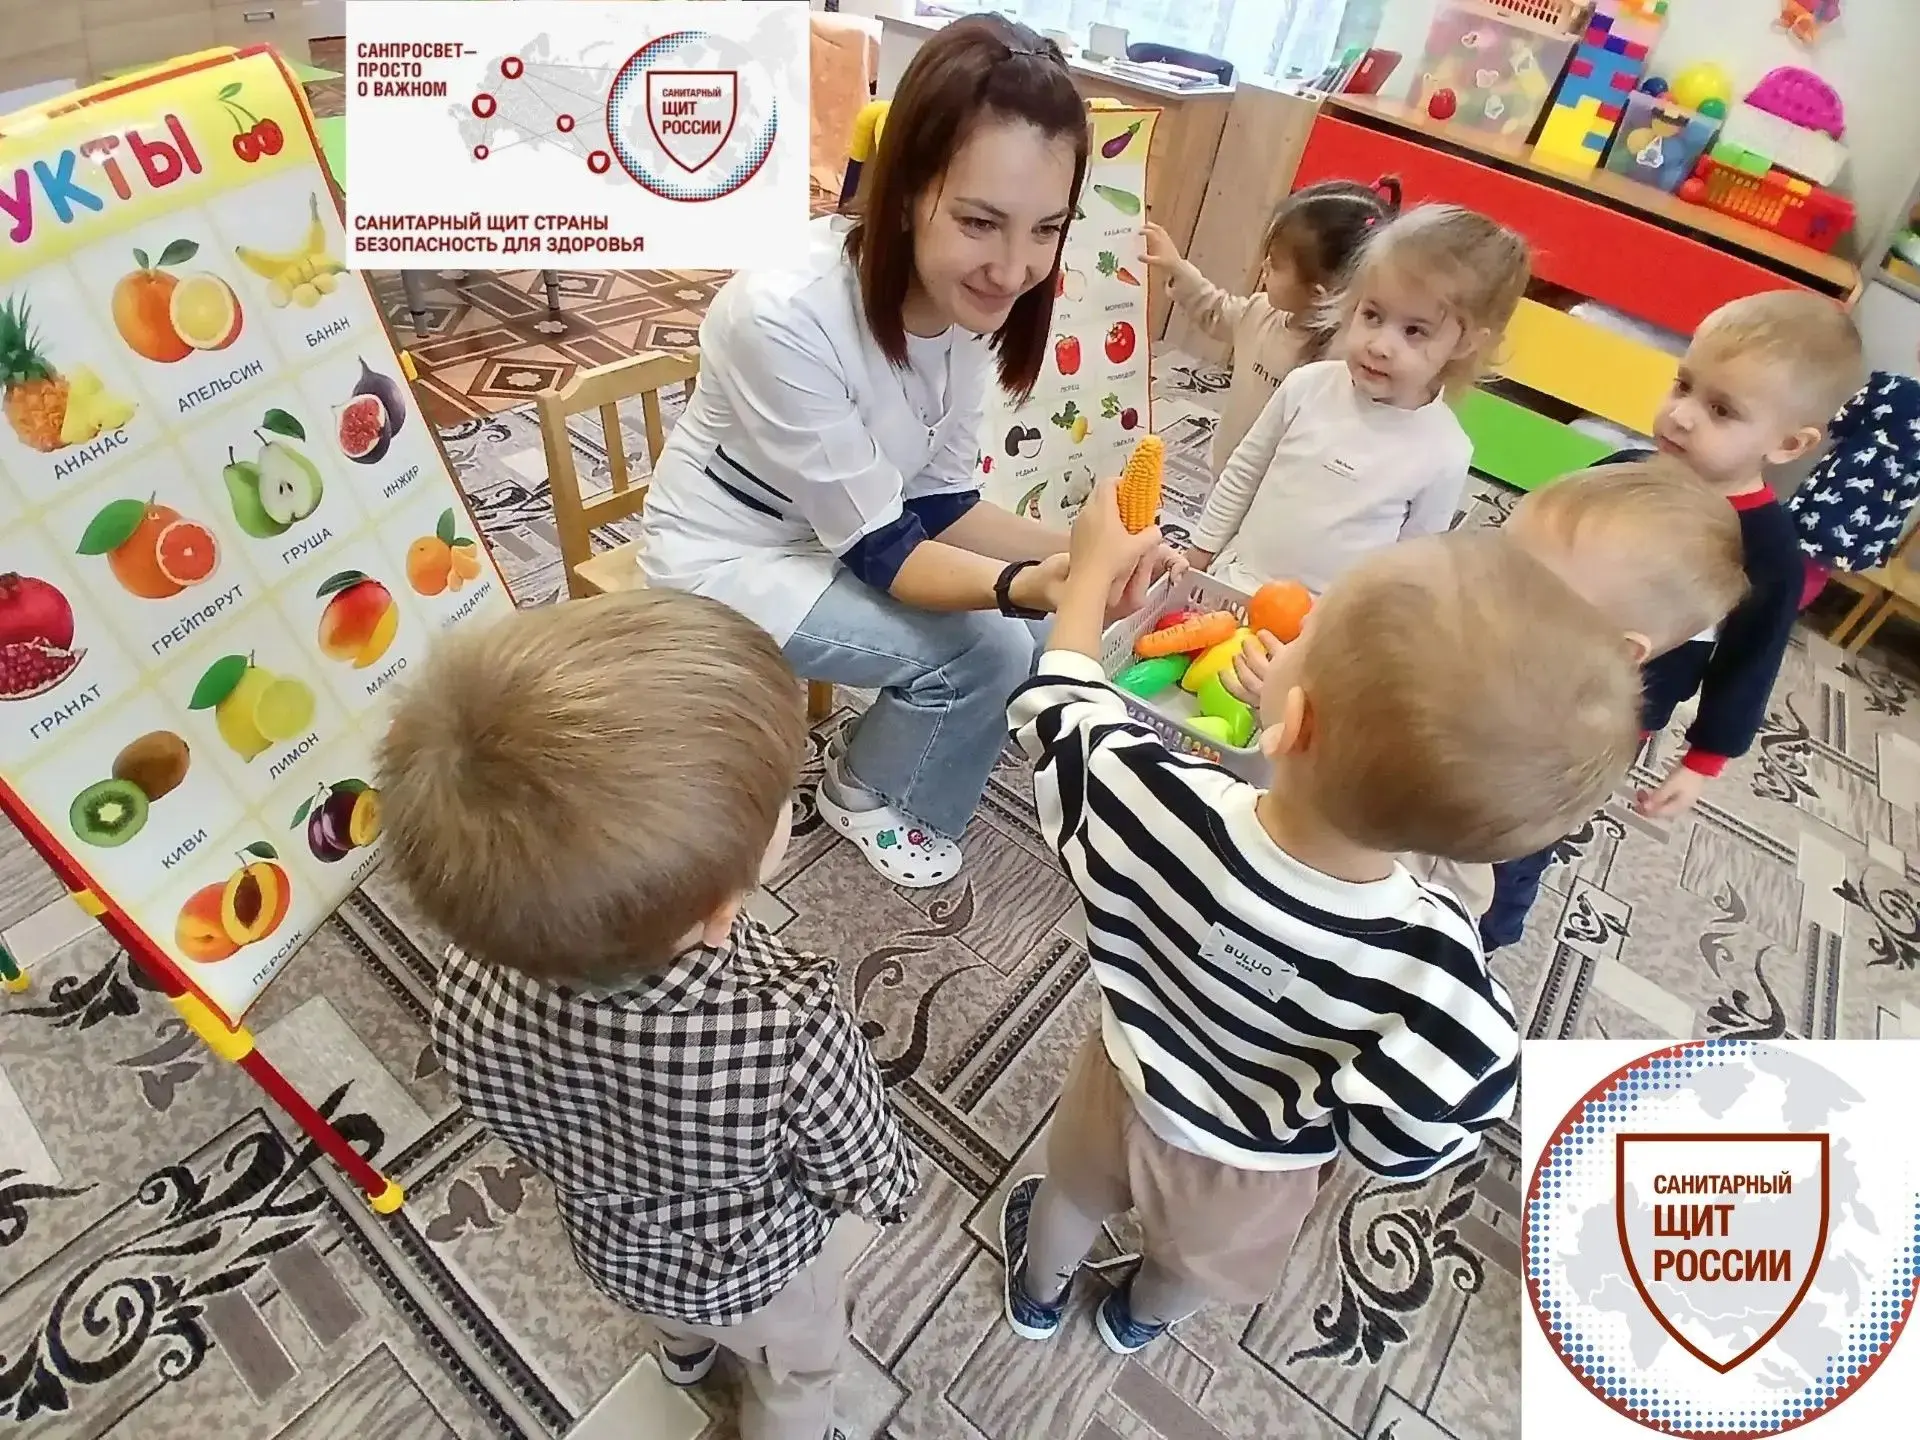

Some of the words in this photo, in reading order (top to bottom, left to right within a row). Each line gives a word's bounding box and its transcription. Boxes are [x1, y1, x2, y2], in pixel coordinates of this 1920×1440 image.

[305, 316, 351, 348] БАНАН
[178, 359, 264, 413] АПЕЛЬСИН
[54, 429, 129, 481] АНАНАС
[383, 465, 419, 499] ИНЖИР
[281, 528, 333, 565] ГРУША
[151, 584, 243, 656] ГРЕЙПФРУТ
[366, 657, 407, 696] МАНГО
[29, 683, 101, 740] ГРАНАТ
[269, 732, 319, 780] ЛИМОН
[161, 828, 208, 869] КИВИ
[252, 930, 304, 986] ПЕРСИК
[1224, 944, 1272, 976] BULUO
